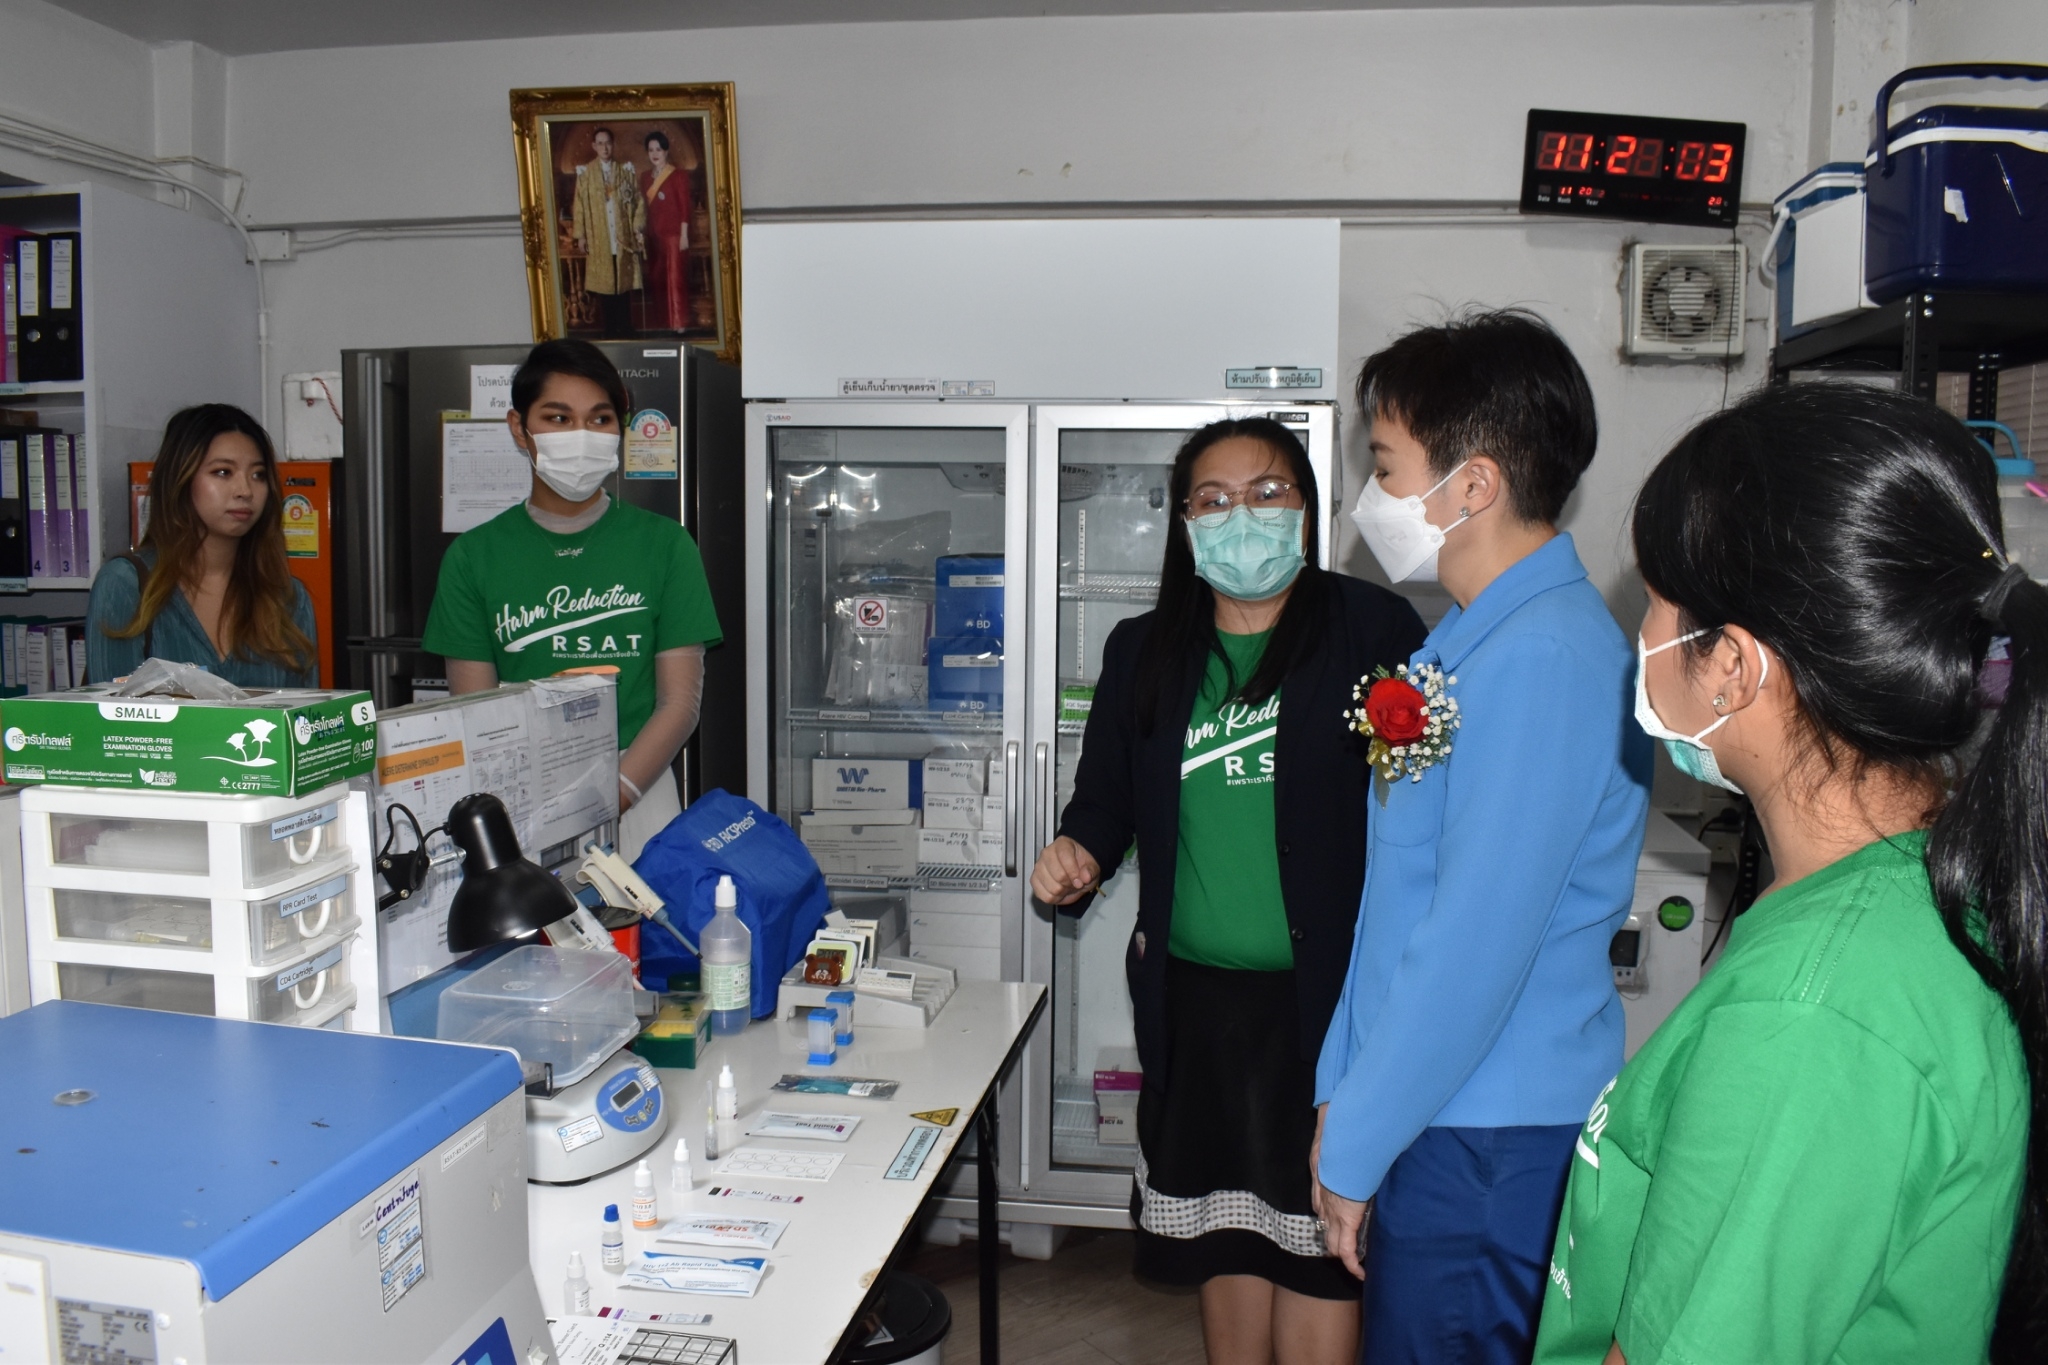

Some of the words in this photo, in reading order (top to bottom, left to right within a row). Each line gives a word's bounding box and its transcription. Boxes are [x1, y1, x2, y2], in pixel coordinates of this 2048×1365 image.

[646, 424, 655, 436] 5
[34, 560, 41, 572] 4
[62, 561, 70, 573] 3
[494, 603, 549, 644] Harm
[546, 584, 646, 620] Reduction
[976, 620, 991, 629] BD
[970, 701, 985, 710] BD
[114, 706, 161, 720] SMALL
[360, 706, 369, 721] S
[124, 736, 173, 745] POWDER-FREE
[361, 738, 374, 752] 100
[103, 743, 146, 751] EXAMINATION
[147, 745, 173, 753] GLOVES
[282, 903, 293, 912] RPR
[293, 898, 306, 909] Card
[306, 893, 318, 904] Test
[280, 975, 291, 986] CD4
[292, 966, 314, 981] Cartridge
[376, 1180, 420, 1222] Centrifuge
